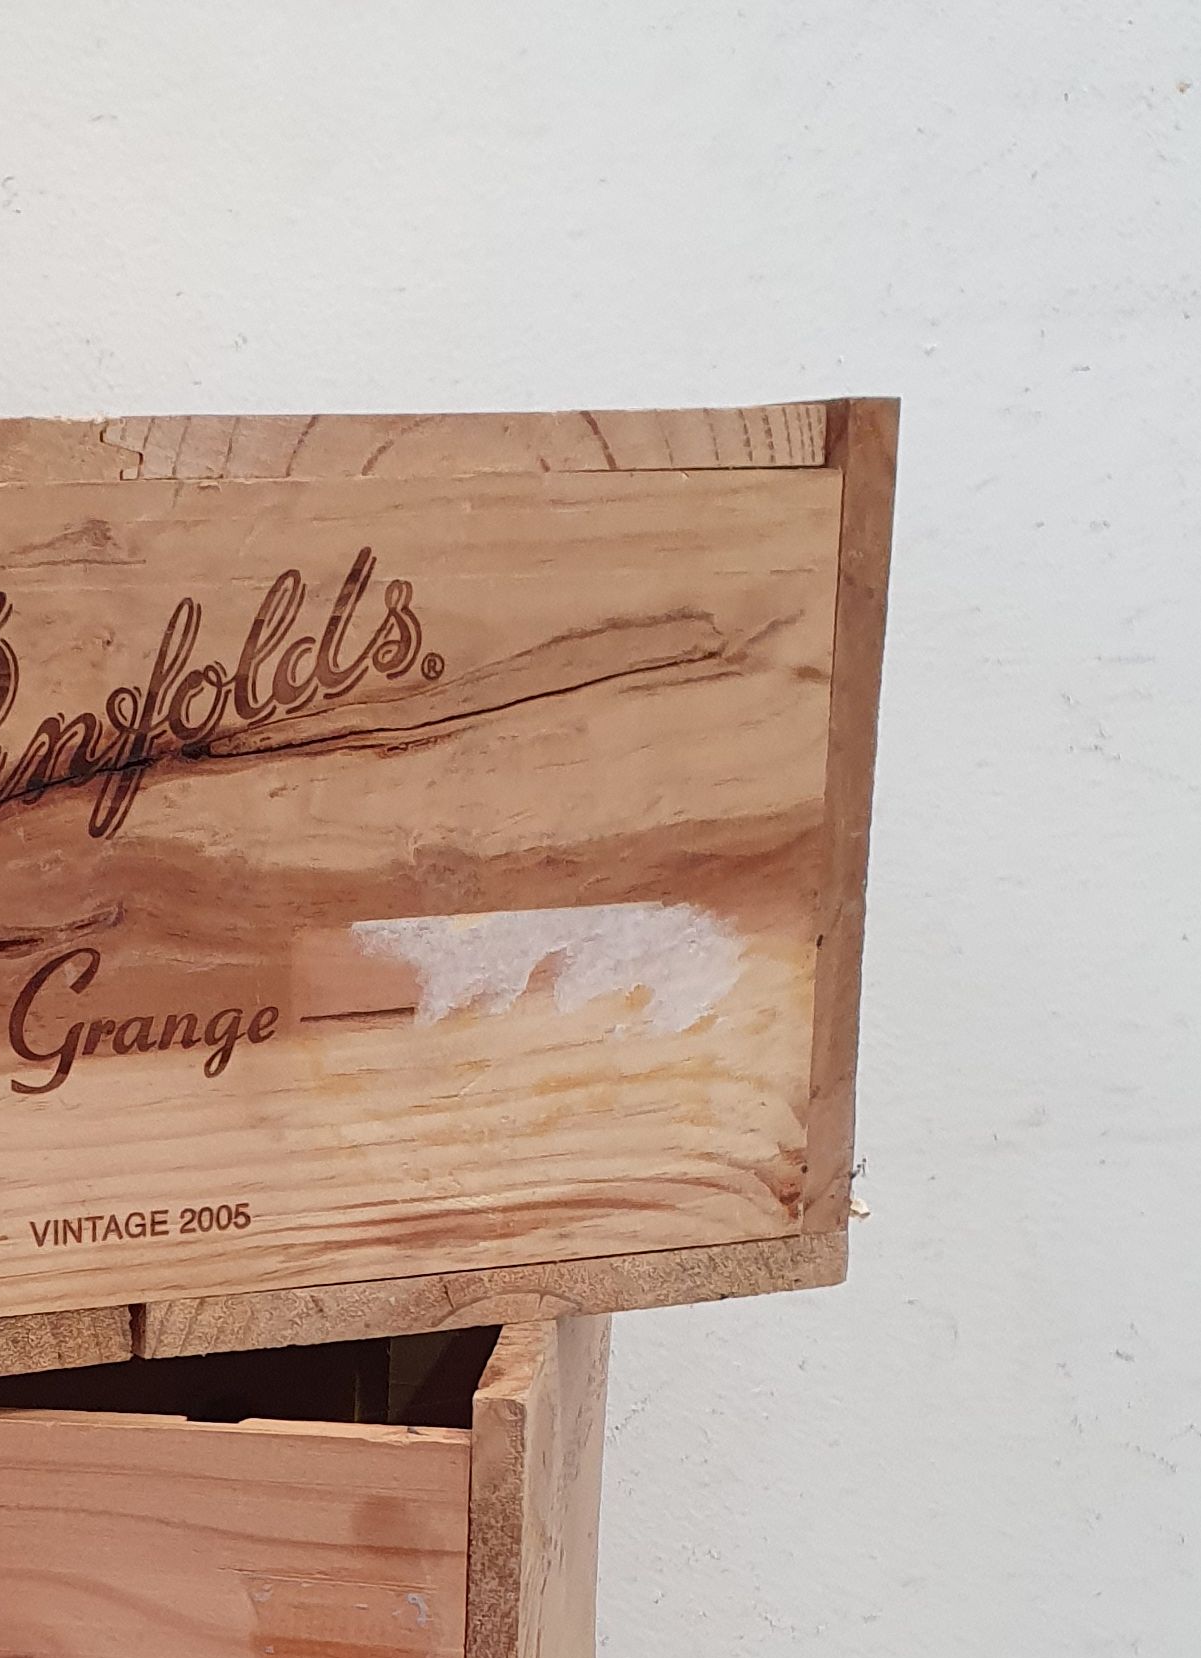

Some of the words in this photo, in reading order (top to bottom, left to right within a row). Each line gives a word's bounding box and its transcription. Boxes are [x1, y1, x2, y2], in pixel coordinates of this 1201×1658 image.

[8, 948, 279, 1093] Grange
[30, 1210, 169, 1248] VINTAGE
[179, 1203, 251, 1234] 2005
